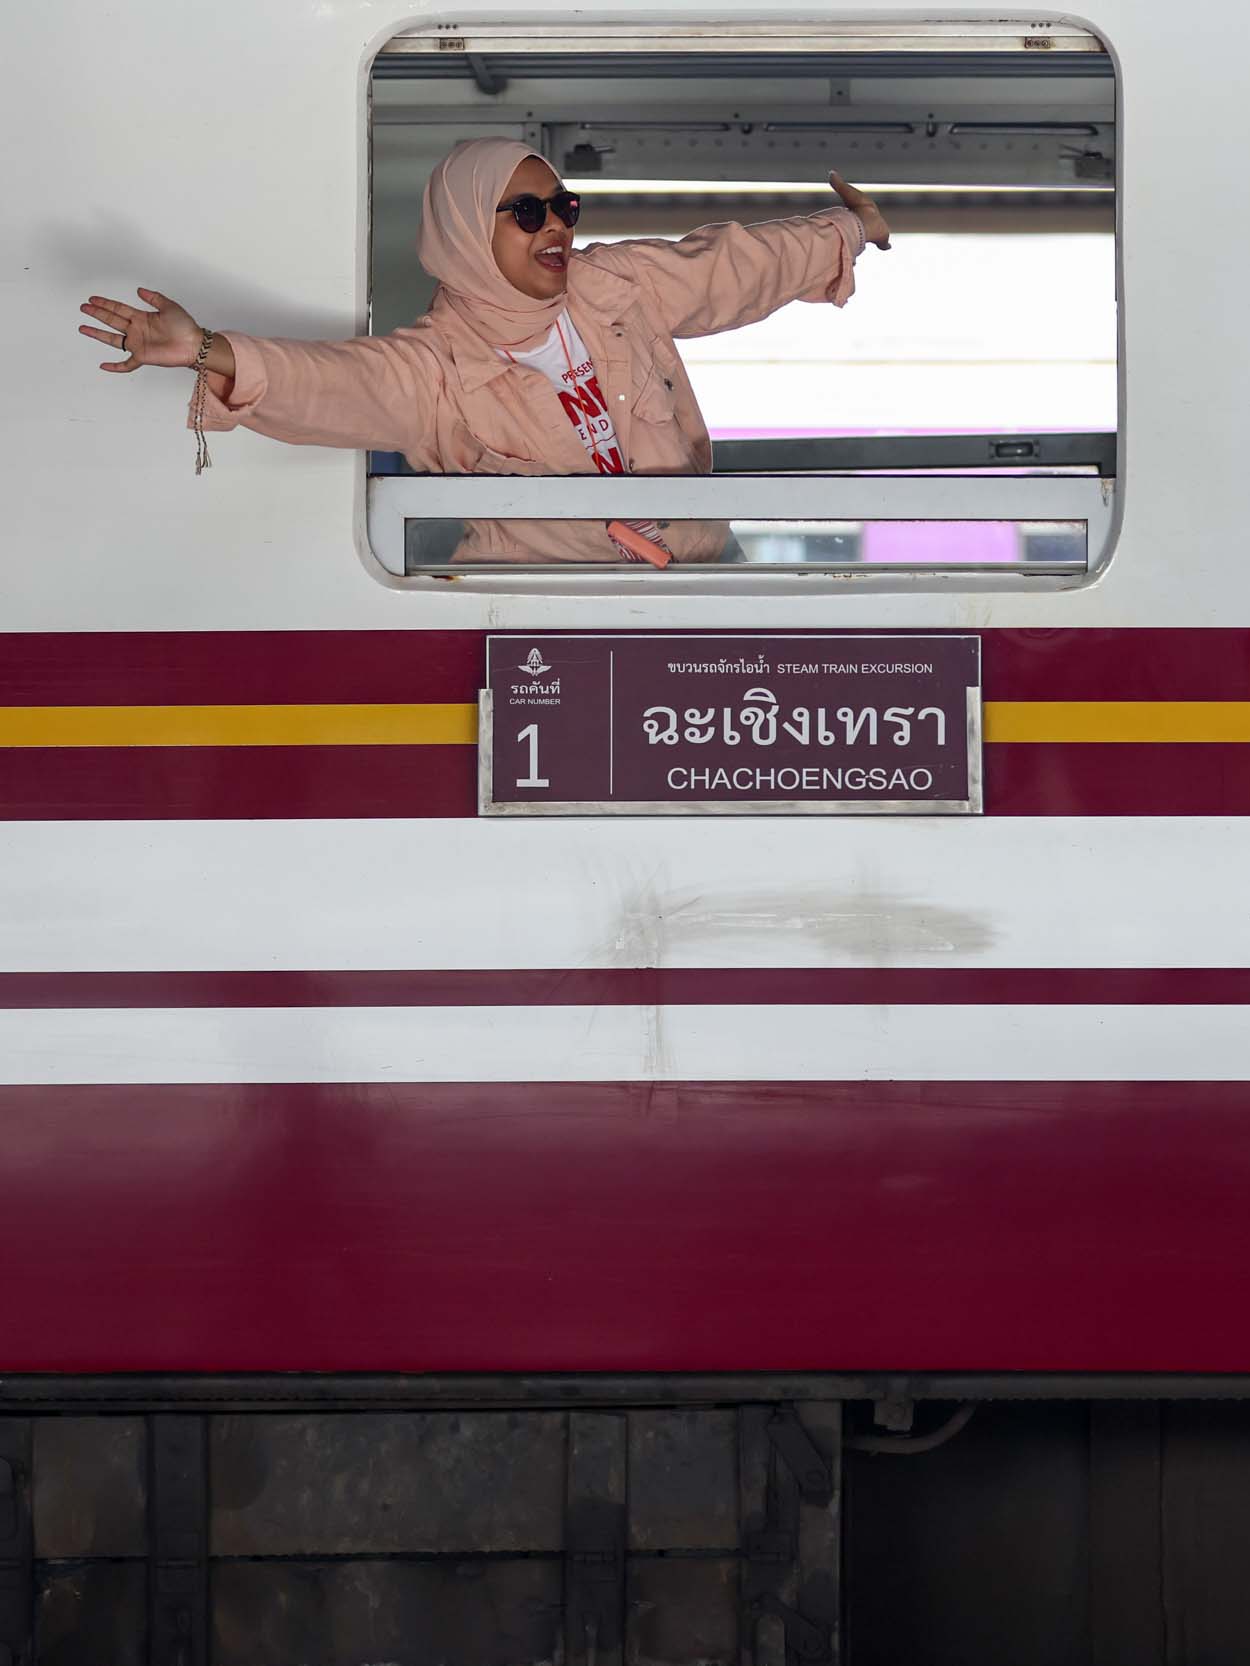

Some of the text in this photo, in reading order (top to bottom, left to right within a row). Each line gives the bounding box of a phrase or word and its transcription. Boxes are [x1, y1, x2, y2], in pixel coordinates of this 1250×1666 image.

[667, 654, 933, 674] ขบวนรถจักรไอน้ำ STEAM TRAIN EXCURSION
[510, 677, 561, 695] รถคันที่
[642, 687, 946, 746] ฉะเชิงเทรา
[516, 723, 550, 788] 1
[667, 767, 933, 791] CHACHOENGSAO
